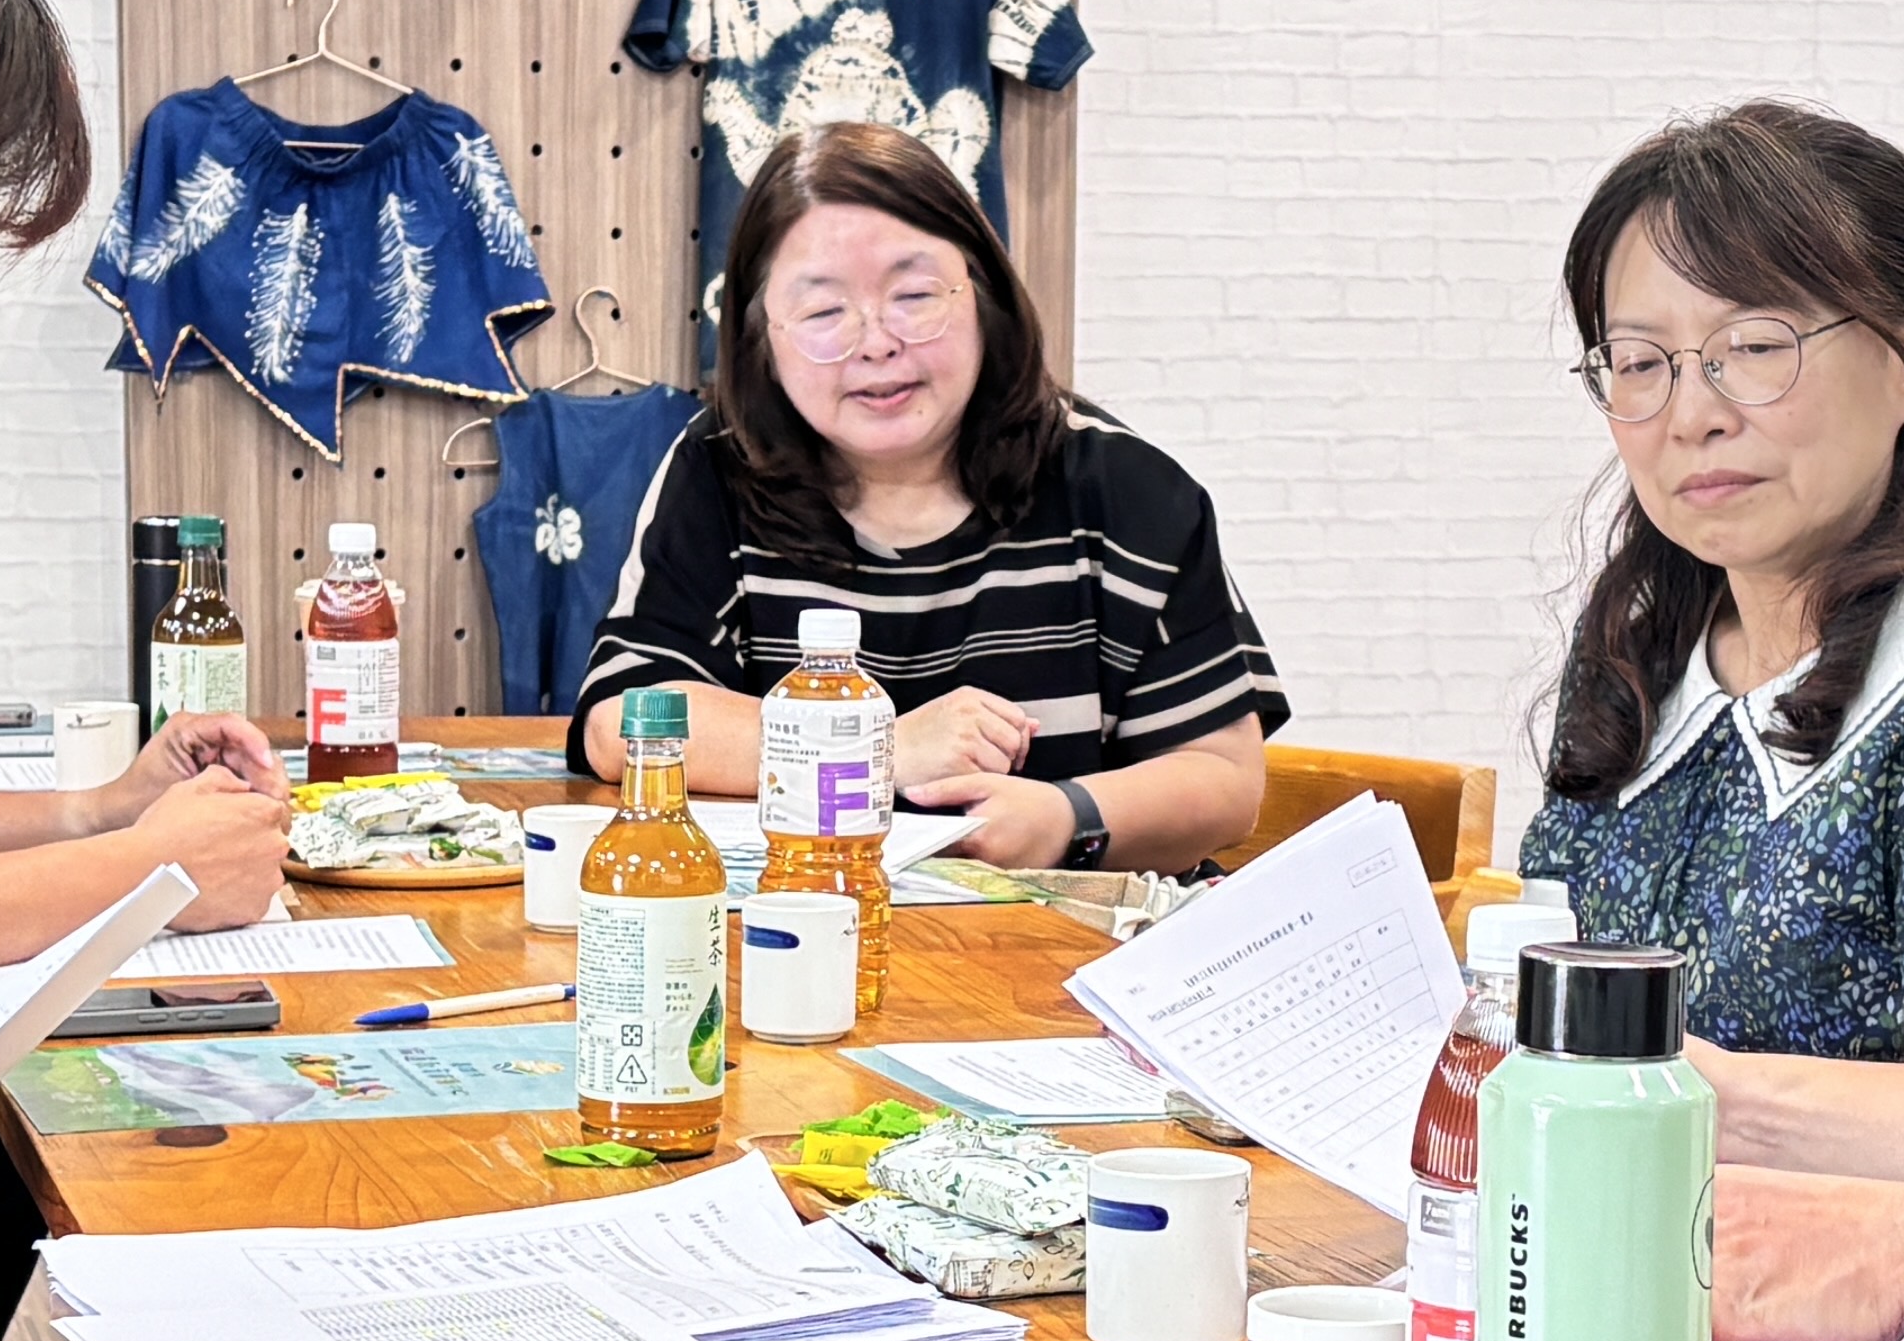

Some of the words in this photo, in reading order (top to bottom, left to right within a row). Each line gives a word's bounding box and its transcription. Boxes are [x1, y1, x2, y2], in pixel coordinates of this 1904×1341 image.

[312, 688, 347, 744] F
[818, 760, 870, 837] F
[708, 904, 723, 967] 生茶
[627, 1064, 634, 1079] 1
